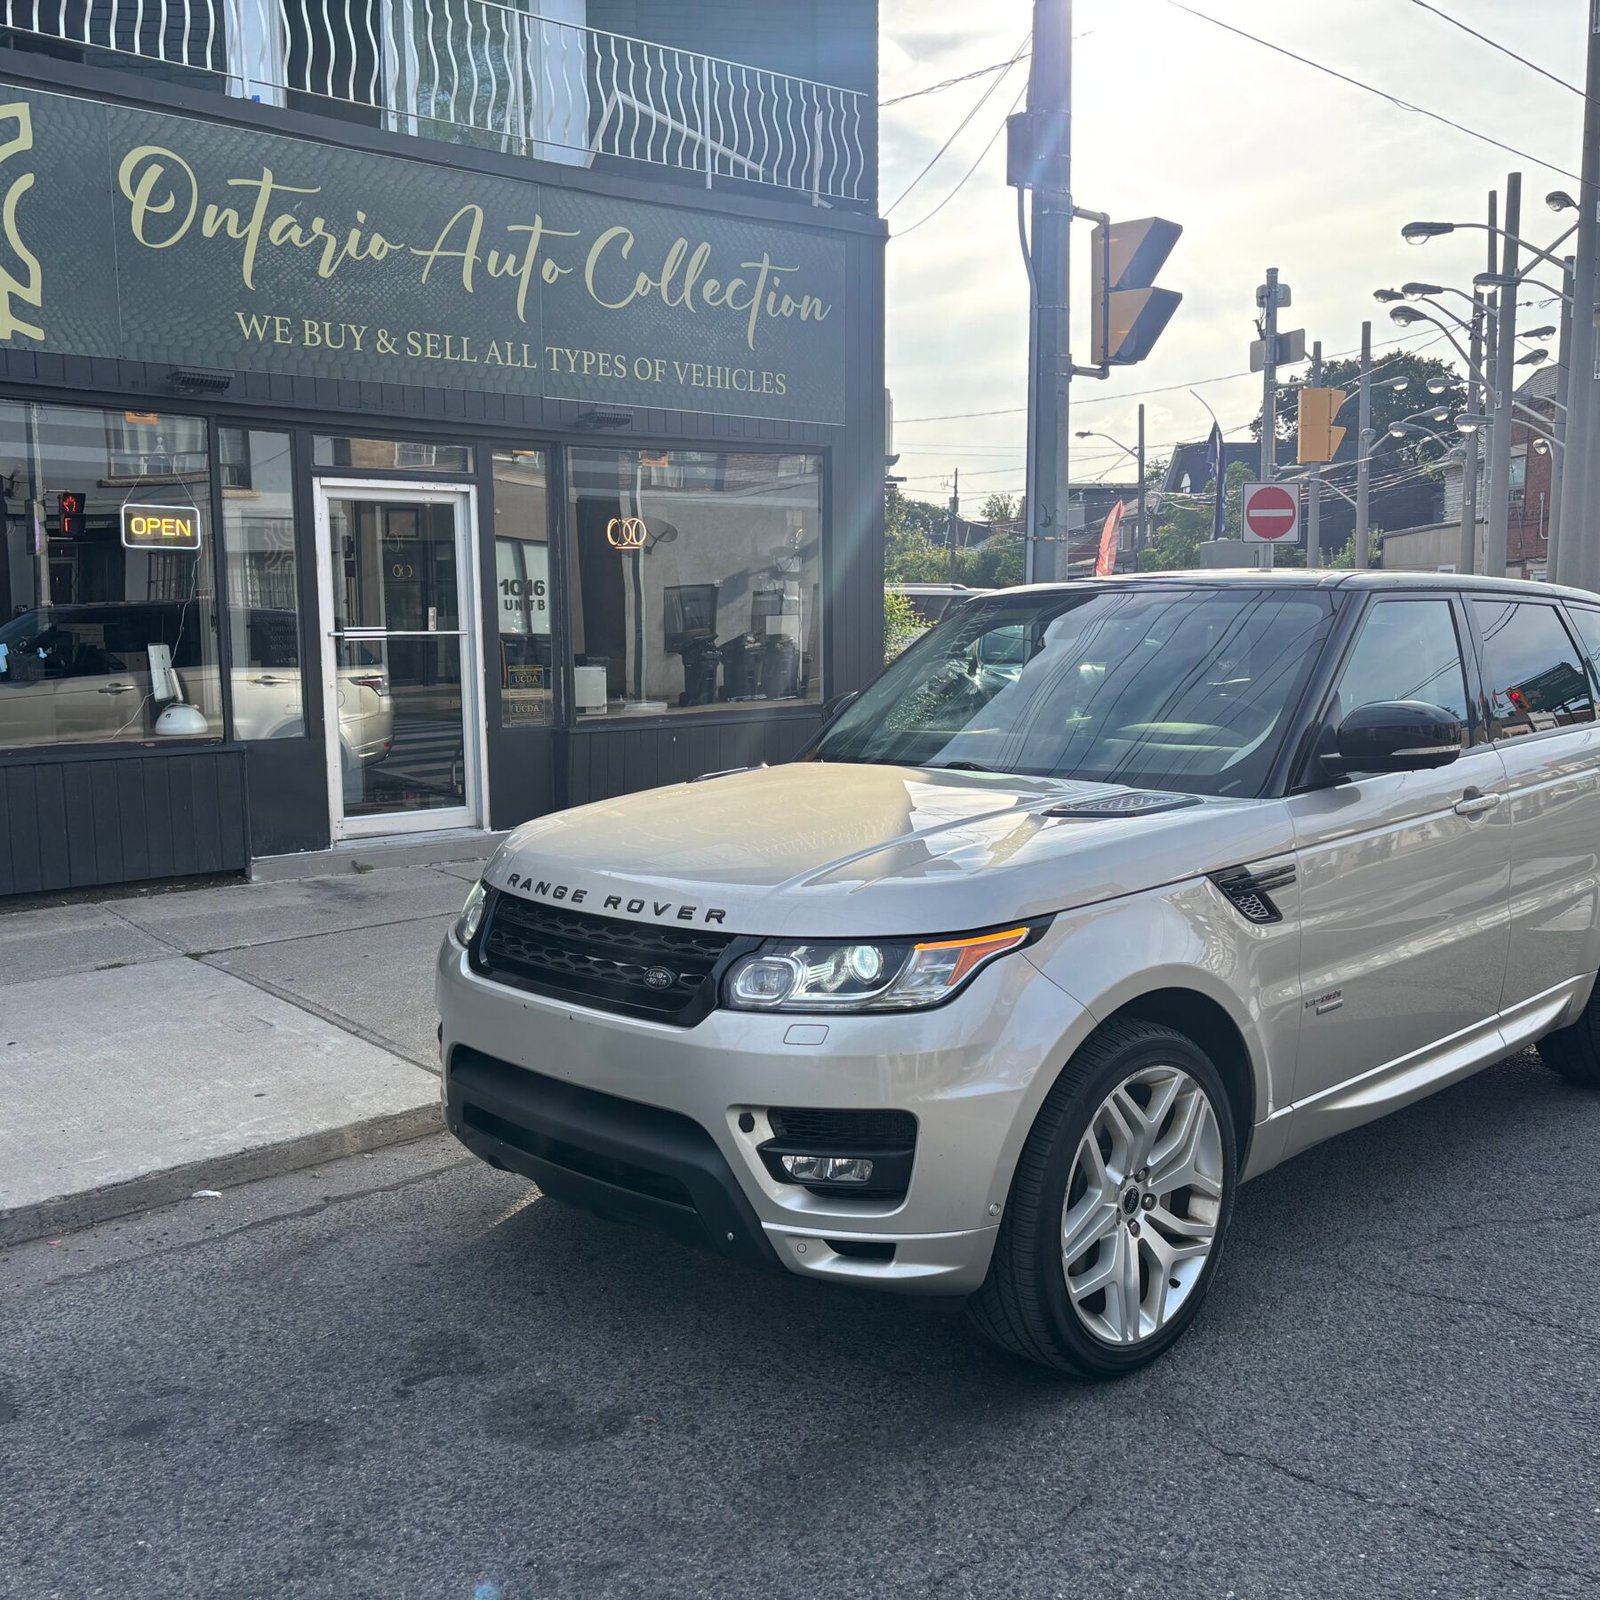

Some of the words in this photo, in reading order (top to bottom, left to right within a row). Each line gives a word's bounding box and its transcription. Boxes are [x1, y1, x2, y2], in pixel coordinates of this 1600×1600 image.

[118, 145, 404, 290] Ontario
[410, 203, 581, 324] Auto
[584, 226, 832, 351] Collection
[234, 311, 294, 345] WE
[302, 319, 368, 351] BUY
[376, 328, 399, 355] &
[406, 330, 478, 363] SELL
[484, 339, 538, 369] ALL
[545, 346, 627, 378] TYPES
[633, 357, 668, 383] OF
[673, 361, 787, 395] VEHICLES
[131, 517, 191, 537] OPEN
[499, 578, 546, 597] 1016
[504, 599, 535, 611] UNT
[537, 599, 546, 611] B
[514, 674, 539, 684] UCDA
[515, 704, 540, 713] UCDA
[507, 873, 588, 903] RANGE
[603, 895, 727, 924] ROVER
